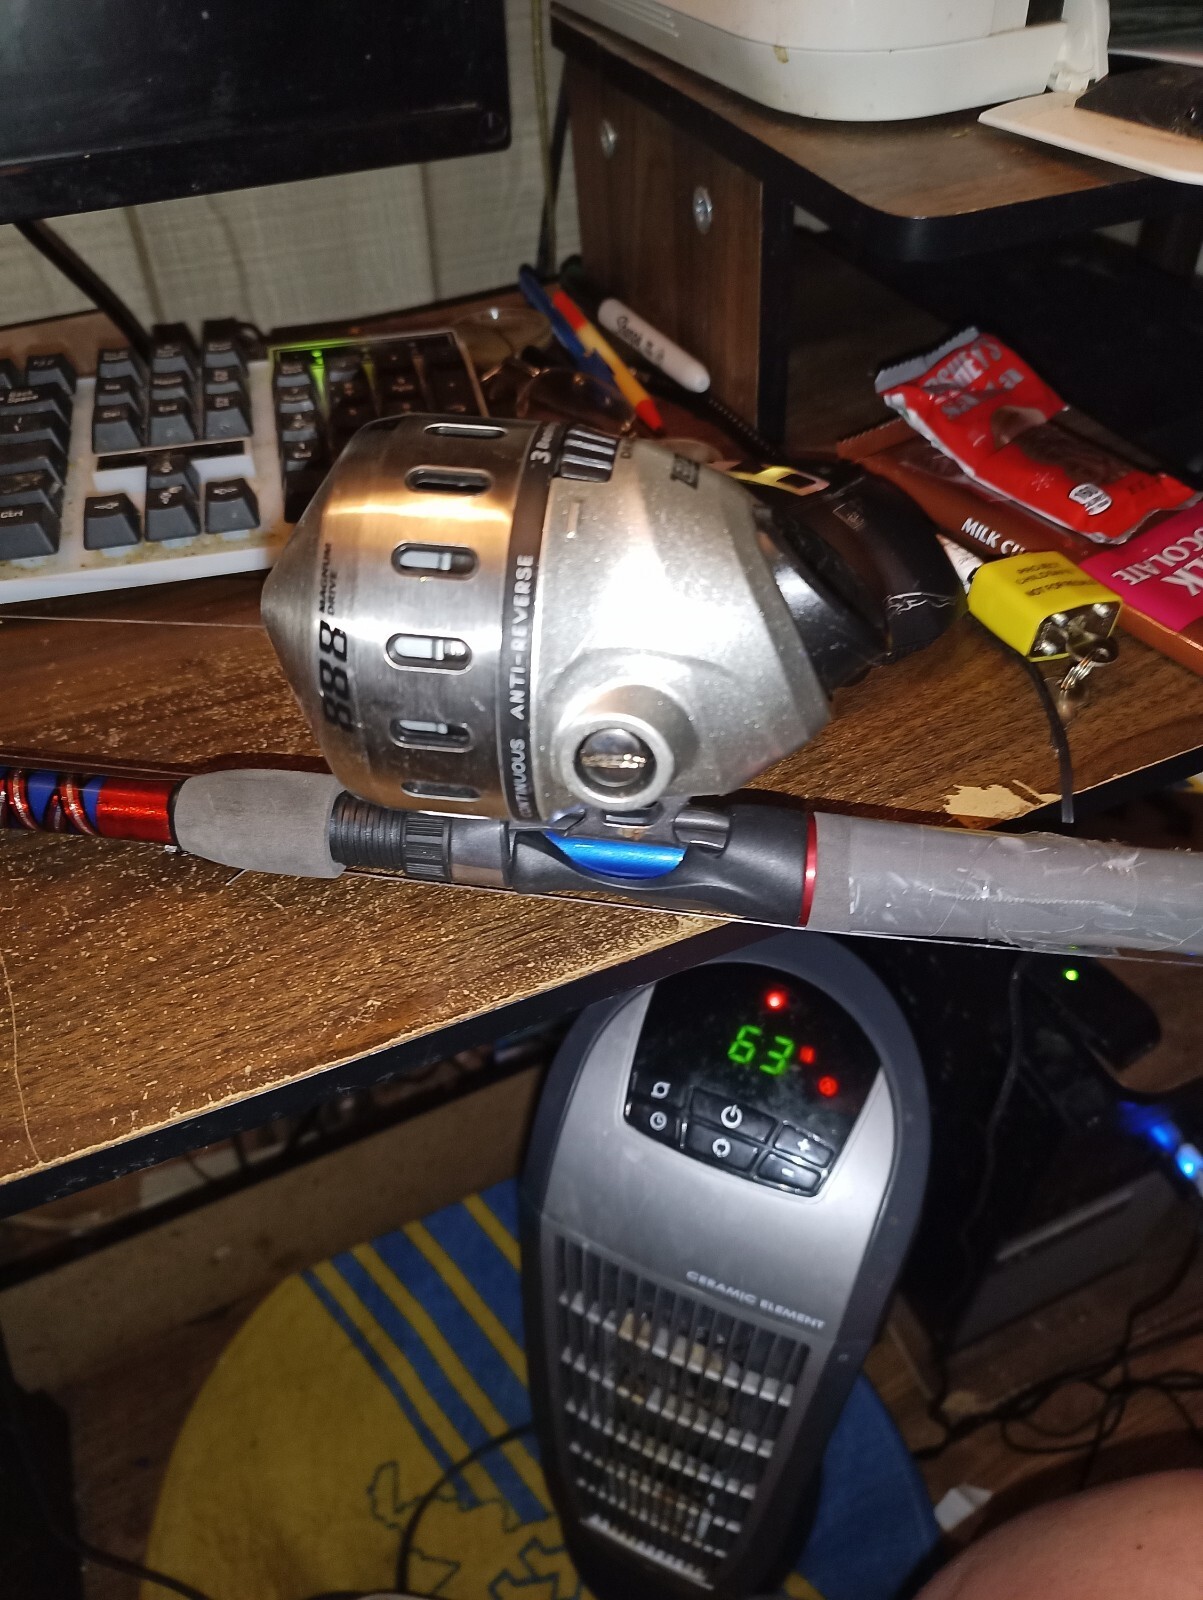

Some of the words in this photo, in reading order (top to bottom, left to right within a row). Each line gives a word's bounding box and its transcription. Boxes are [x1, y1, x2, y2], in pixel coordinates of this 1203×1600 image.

[961, 517, 1001, 549] MILK
[319, 543, 331, 613] MAGNUM
[327, 571, 338, 616] DRIVE
[509, 554, 534, 721] ANTI-REVERSE
[319, 619, 352, 732] 888
[728, 1025, 794, 1075] 63
[686, 1270, 757, 1306] CERAMIC
[759, 1299, 825, 1330] ELEMENT
